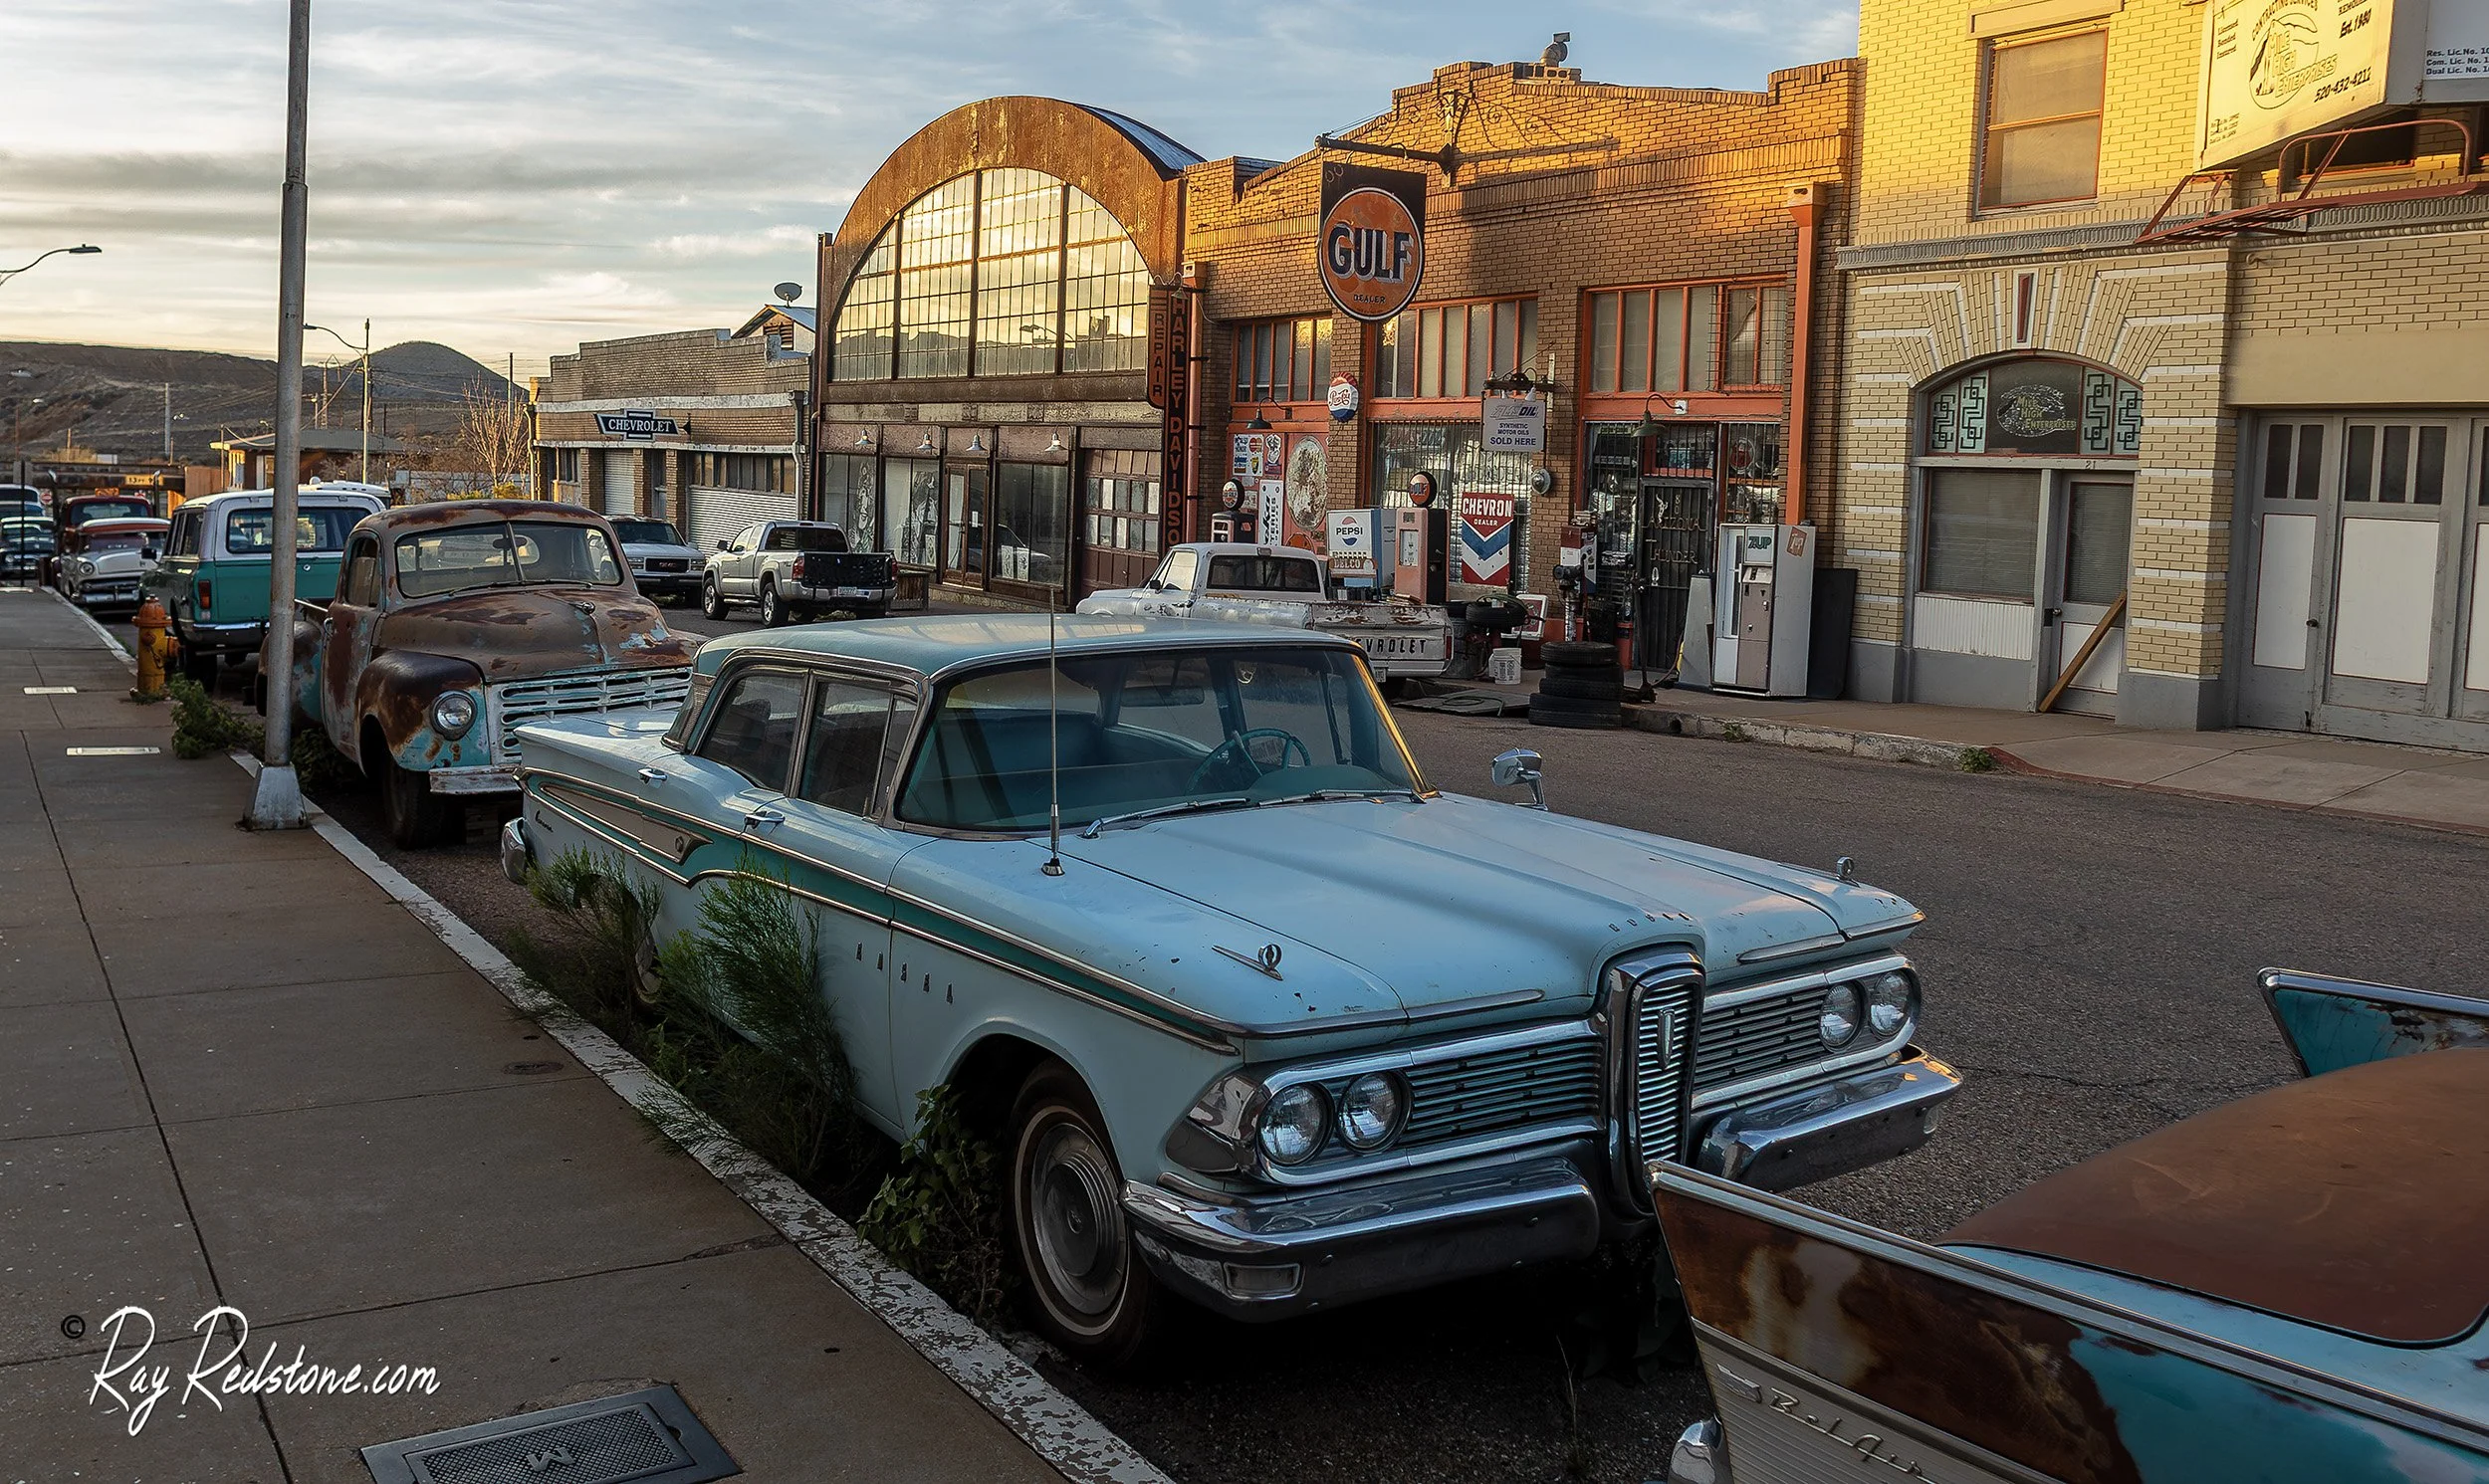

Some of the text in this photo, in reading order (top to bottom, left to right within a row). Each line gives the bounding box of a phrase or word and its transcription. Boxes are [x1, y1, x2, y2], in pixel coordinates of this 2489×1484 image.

[2268, 30, 2290, 56] MILE
[2275, 54, 2338, 98] ENTERPRISES
[1327, 220, 1414, 283] GULF
[1354, 294, 1386, 305] DEALER
[1152, 313, 1166, 397] REPAIR
[1171, 296, 1186, 409] HARLEY
[607, 418, 672, 432] CHEVROLET
[2024, 418, 2076, 430] ENTERPRISES
[1489, 436, 1536, 446] SOLD HERE
[2086, 460, 2097, 471] 21
[1168, 416, 1184, 544] DAVIDSO
[1462, 498, 1512, 518] CHEVRON
[1335, 527, 1363, 535] PEPSI
[1645, 538, 1698, 564] THUNDER
[1334, 558, 1361, 568] DELCO
